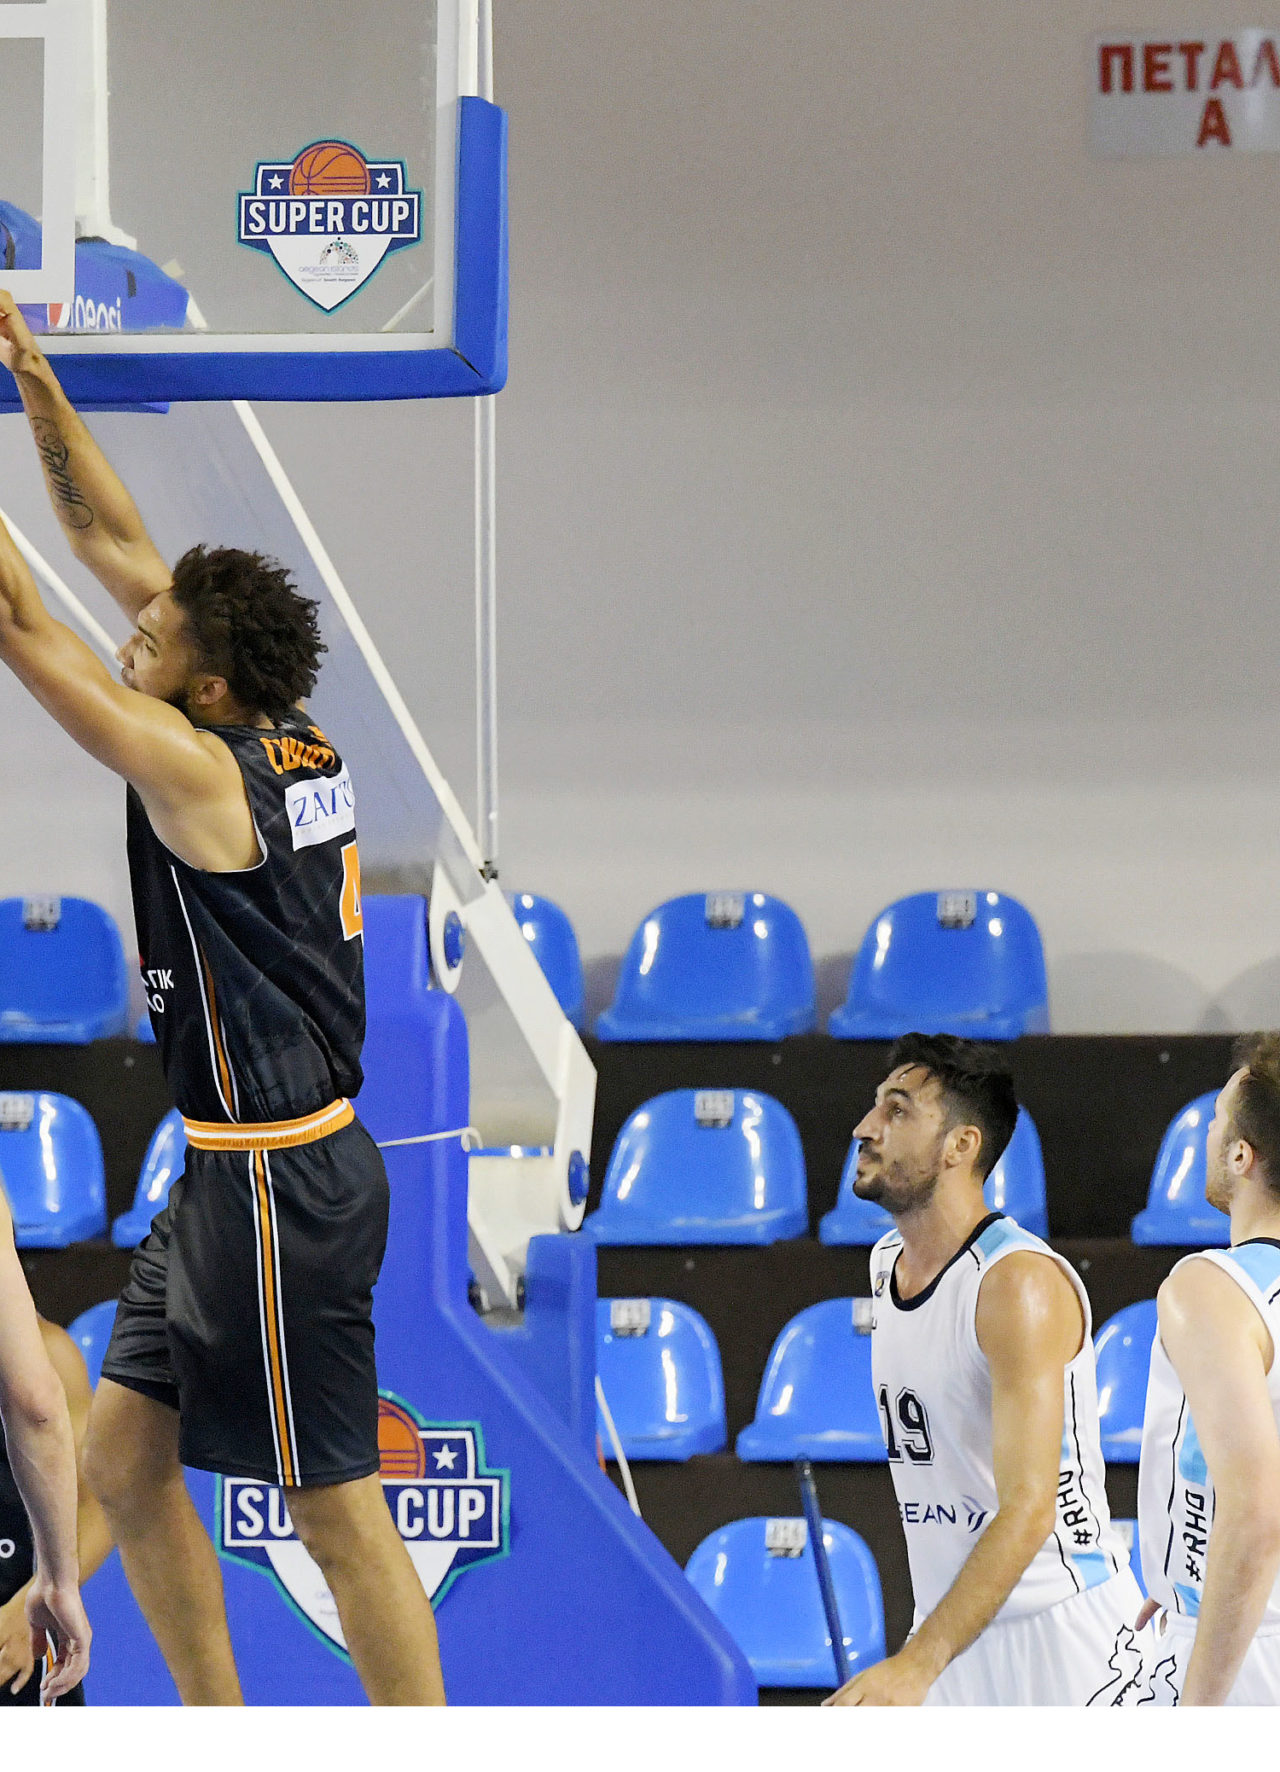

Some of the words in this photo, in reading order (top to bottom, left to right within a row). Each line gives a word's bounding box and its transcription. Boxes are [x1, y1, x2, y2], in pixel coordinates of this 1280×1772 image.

[248, 201, 345, 233] SUPER
[351, 200, 410, 232] CUP
[879, 1383, 936, 1466] 19
[397, 1487, 486, 1539] CUP
